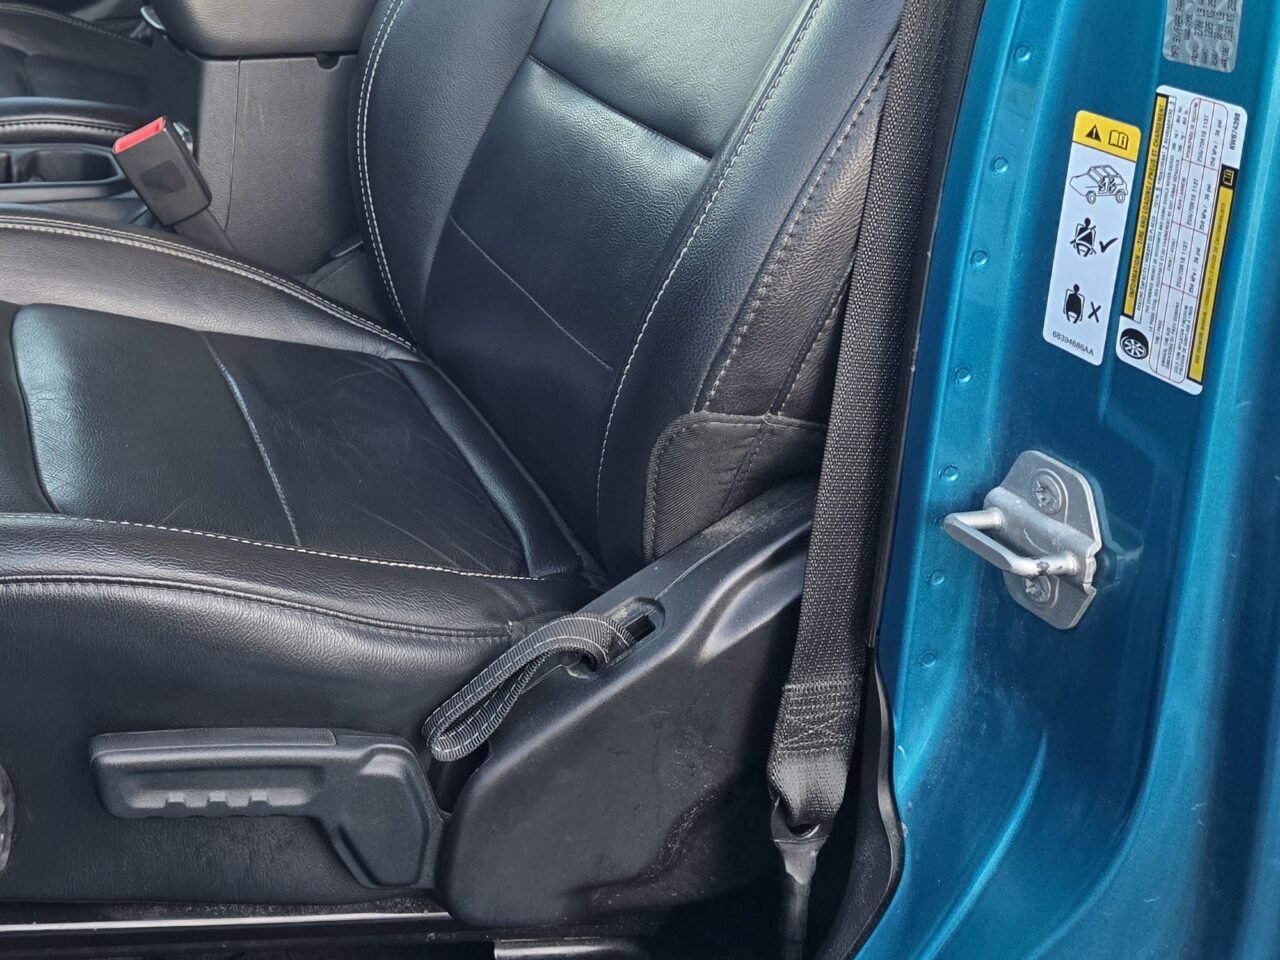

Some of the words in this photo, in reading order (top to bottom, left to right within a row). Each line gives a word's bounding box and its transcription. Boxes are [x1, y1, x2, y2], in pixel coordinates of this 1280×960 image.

[1151, 103, 1164, 147] CHARGEMENT
[1228, 111, 1241, 150] KW674398
[1150, 148, 1157, 156] ET
[1146, 157, 1156, 180] PNEUS
[1141, 184, 1152, 214] LOADING
[1139, 215, 1147, 229] AND
[1136, 229, 1145, 245] TIRE
[1128, 254, 1141, 298] INFORMATION
